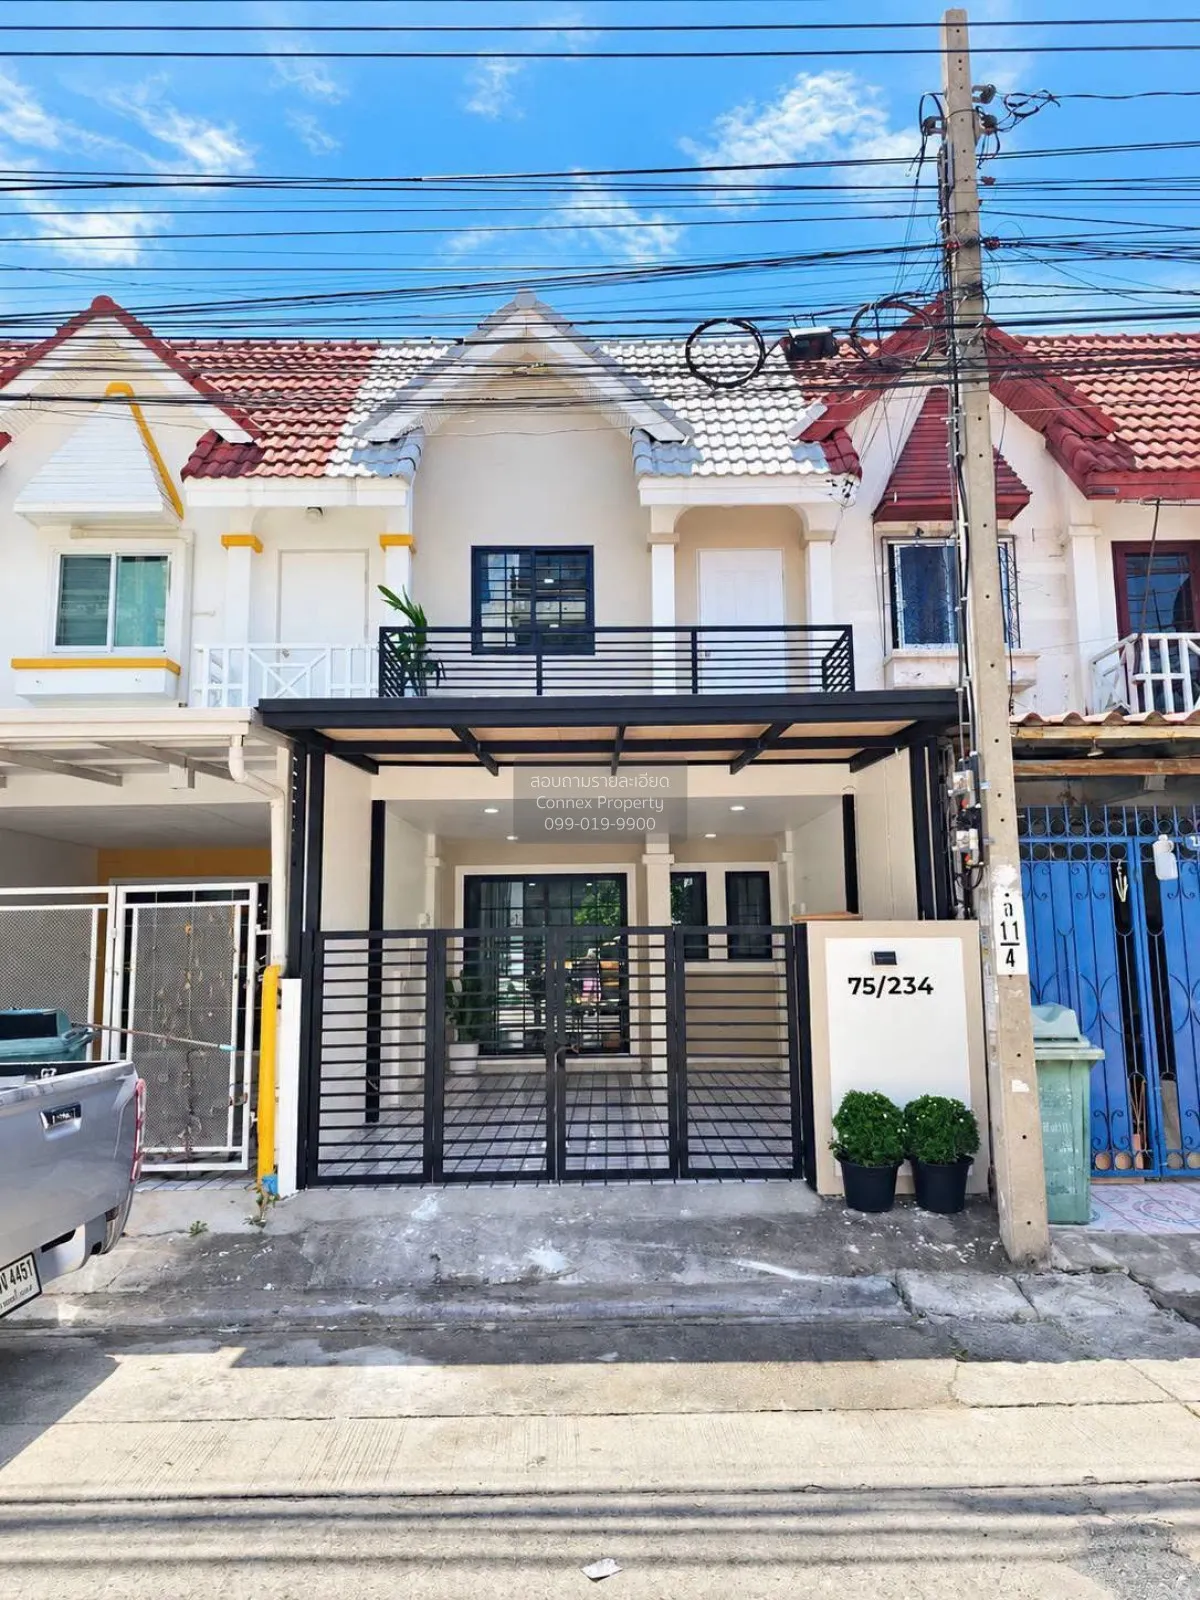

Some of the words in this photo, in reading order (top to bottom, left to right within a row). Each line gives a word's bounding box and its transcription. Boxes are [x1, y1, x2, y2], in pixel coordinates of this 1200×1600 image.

[1000, 920, 1019, 940] 11
[1005, 948, 1015, 967] 4
[848, 975, 934, 999] 75/234
[10, 1259, 33, 1285] 4451
